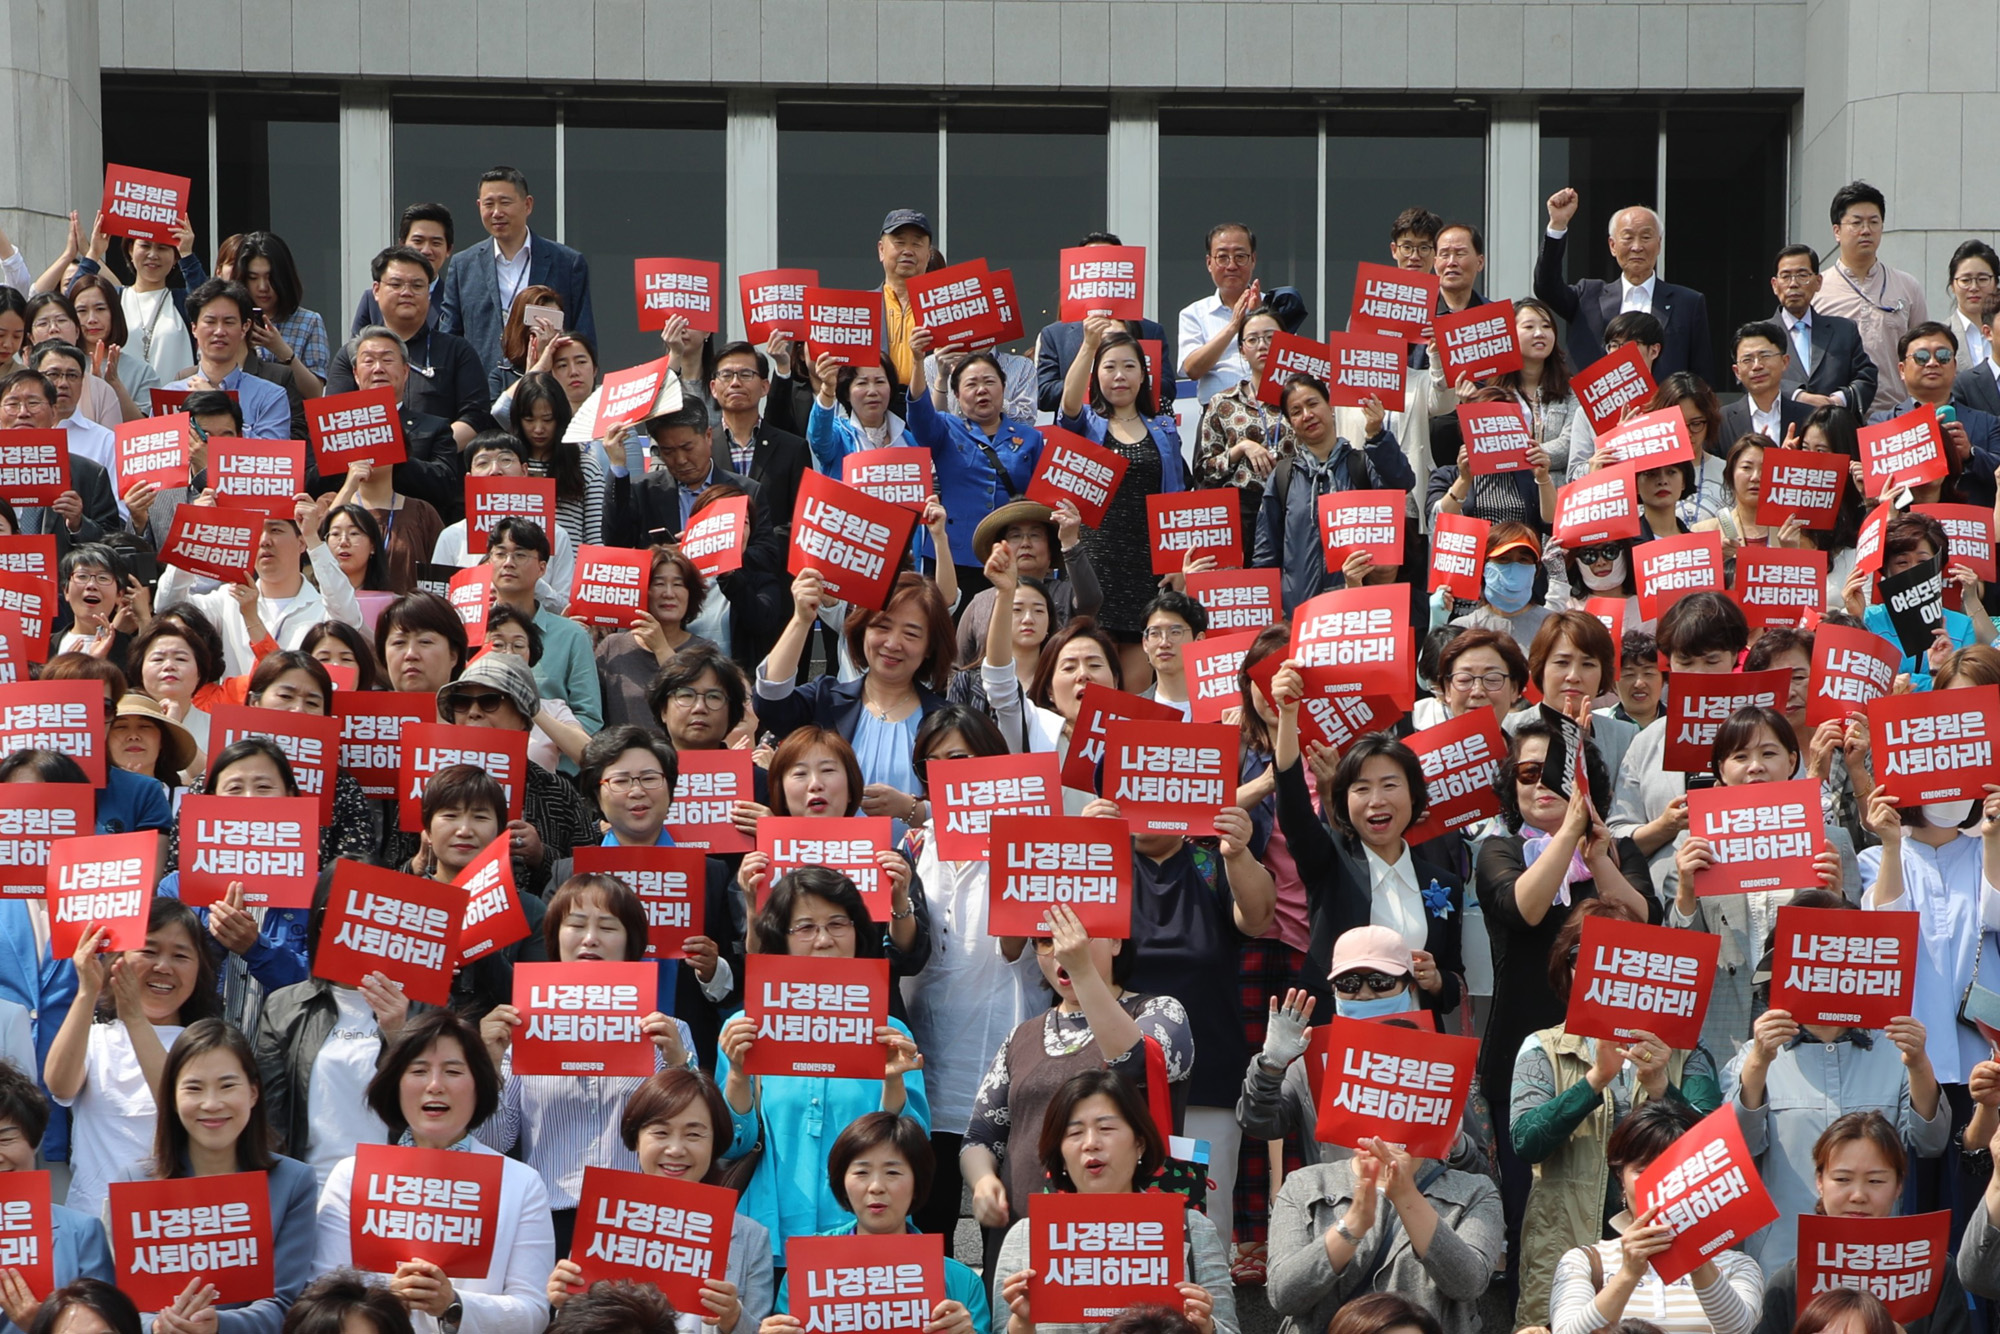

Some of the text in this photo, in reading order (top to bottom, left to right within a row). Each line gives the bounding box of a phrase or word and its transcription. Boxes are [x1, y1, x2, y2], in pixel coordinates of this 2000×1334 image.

[114, 181, 178, 206] 나경원은
[109, 199, 178, 226] 사퇴하라!
[645, 273, 708, 293] 나경원은
[1069, 261, 1134, 281] 나경원은
[644, 292, 710, 312] 사퇴하라!
[919, 278, 981, 309] 나경원은
[1068, 281, 1135, 301] 사퇴하라!
[1365, 279, 1428, 305] 나경원은
[809, 304, 870, 325] 나경원은
[923, 297, 989, 329] 사퇴하라!
[1359, 298, 1428, 325] 사퇴하라!
[809, 325, 872, 346] 사퇴하라!
[1446, 316, 1507, 347] 나경원은
[1340, 349, 1399, 369] 나경원은
[1450, 335, 1513, 367] 사퇴하라!
[608, 371, 656, 401] 나경원은
[1337, 369, 1400, 391] 사퇴하라!
[1582, 360, 1637, 403] 나경원은
[1592, 377, 1649, 422] 사퇴하라!
[318, 404, 387, 433] 나경원은
[1468, 415, 1523, 435] 나경원은
[122, 430, 179, 456] 나경원은
[322, 425, 394, 454] 사퇴하라!
[1473, 432, 1532, 454] 사퇴하라!
[1869, 422, 1931, 457] 나경원은
[0, 446, 57, 465] 경원은
[121, 450, 181, 477] 사퇴하라!
[219, 455, 292, 475] 나경원은
[1052, 446, 1114, 487] 나경원은
[1871, 442, 1937, 477] 사퇴하라!
[0, 467, 60, 486] 퇴하라!
[216, 477, 294, 497] 사퇴하라!
[852, 464, 920, 484] 나경원은
[1041, 466, 1107, 507] 사퇴하라!
[1772, 466, 1837, 488] 나경원은
[476, 493, 543, 512] 나경원은
[1563, 479, 1625, 512] 나경원은
[1766, 487, 1835, 509] 사퇴하라!
[686, 513, 735, 541] 나경원은
[802, 497, 891, 551] 나경원은
[1159, 507, 1228, 529] 나경원은
[1327, 506, 1393, 527] 나경원은
[1559, 498, 1629, 529] 사퇴하라!
[181, 522, 251, 546] 나경원은
[1159, 528, 1232, 551] 사퇴하라!
[1328, 527, 1395, 548] 사퇴하라!
[1436, 531, 1476, 554] 나경원은
[172, 543, 249, 569] 사퇴하라!
[796, 526, 885, 581] 사퇴하라!
[1433, 551, 1476, 576] 사퇴하라!
[1643, 547, 1710, 577] 나경원은
[581, 563, 640, 585] 나경원은
[1643, 568, 1714, 598] 사퇴하라!
[1748, 564, 1816, 585] 나경원은
[576, 584, 639, 607] 사퇴하라!
[1199, 586, 1270, 608] 나경원은
[1743, 586, 1818, 607] 사퇴하라!
[1300, 608, 1392, 642] 나경원은
[1296, 636, 1394, 668] 사퇴하라!
[1826, 648, 1893, 690] 나경원은
[1885, 711, 1985, 745] 나경원은
[1121, 746, 1221, 774] 나경원은
[1420, 733, 1489, 778] 경원은
[1885, 742, 1992, 777] 사퇴하라!
[673, 773, 737, 796] 경원은
[946, 776, 1045, 806] 나경원은
[1115, 776, 1223, 804] 사퇴하라!
[1921, 788, 1961, 799] 더불어민주당
[0, 808, 76, 835] 경원은
[197, 820, 301, 847] 나경원은
[1705, 804, 1805, 834] 나경원은
[774, 840, 874, 864] 나경원은
[1008, 842, 1113, 871] 나경원은
[1708, 832, 1812, 864] 사퇴하라!
[59, 858, 142, 891] 나경원은
[191, 850, 304, 877] 사퇴하라!
[1002, 875, 1117, 903] 사퇴하라!
[1740, 877, 1781, 888] 더불어민주당
[56, 890, 139, 924] 사퇴하라!
[345, 890, 449, 937] 나경원은
[334, 921, 446, 970] 사퇴하라!
[1792, 934, 1900, 965] 나경원은
[1594, 946, 1699, 986] 나경원은
[1784, 967, 1902, 997] 사퇴하라!
[530, 985, 638, 1011] 나경원은
[763, 982, 870, 1013] 나경원은
[1584, 978, 1695, 1018] 사퇴하라!
[525, 1014, 641, 1043] 사퇴하라!
[757, 1014, 873, 1045] 사퇴하라!
[1818, 1011, 1862, 1023] 더불어민주당
[561, 1061, 604, 1072] 더불어민주당
[792, 1062, 836, 1073] 더불어민주당
[1343, 1048, 1455, 1093] 나경원은
[1333, 1082, 1452, 1126] 사퇴하라!
[1647, 1137, 1732, 1206] 나경원은
[368, 1173, 480, 1211] 나경원은
[131, 1203, 251, 1240] 나경원은
[361, 1207, 483, 1246] 사퇴하라!
[596, 1197, 713, 1243] 나경원은
[1048, 1221, 1164, 1252] 나경원은
[1698, 1229, 1736, 1256] 더불어민주당
[130, 1237, 258, 1275] 사퇴하라!
[586, 1231, 712, 1279] 사퇴하라!
[1818, 1239, 1931, 1271] 나경원은
[807, 1264, 924, 1298] 나경원은
[1043, 1256, 1168, 1287] 사퇴하라!
[805, 1299, 930, 1334] 사퇴하라!
